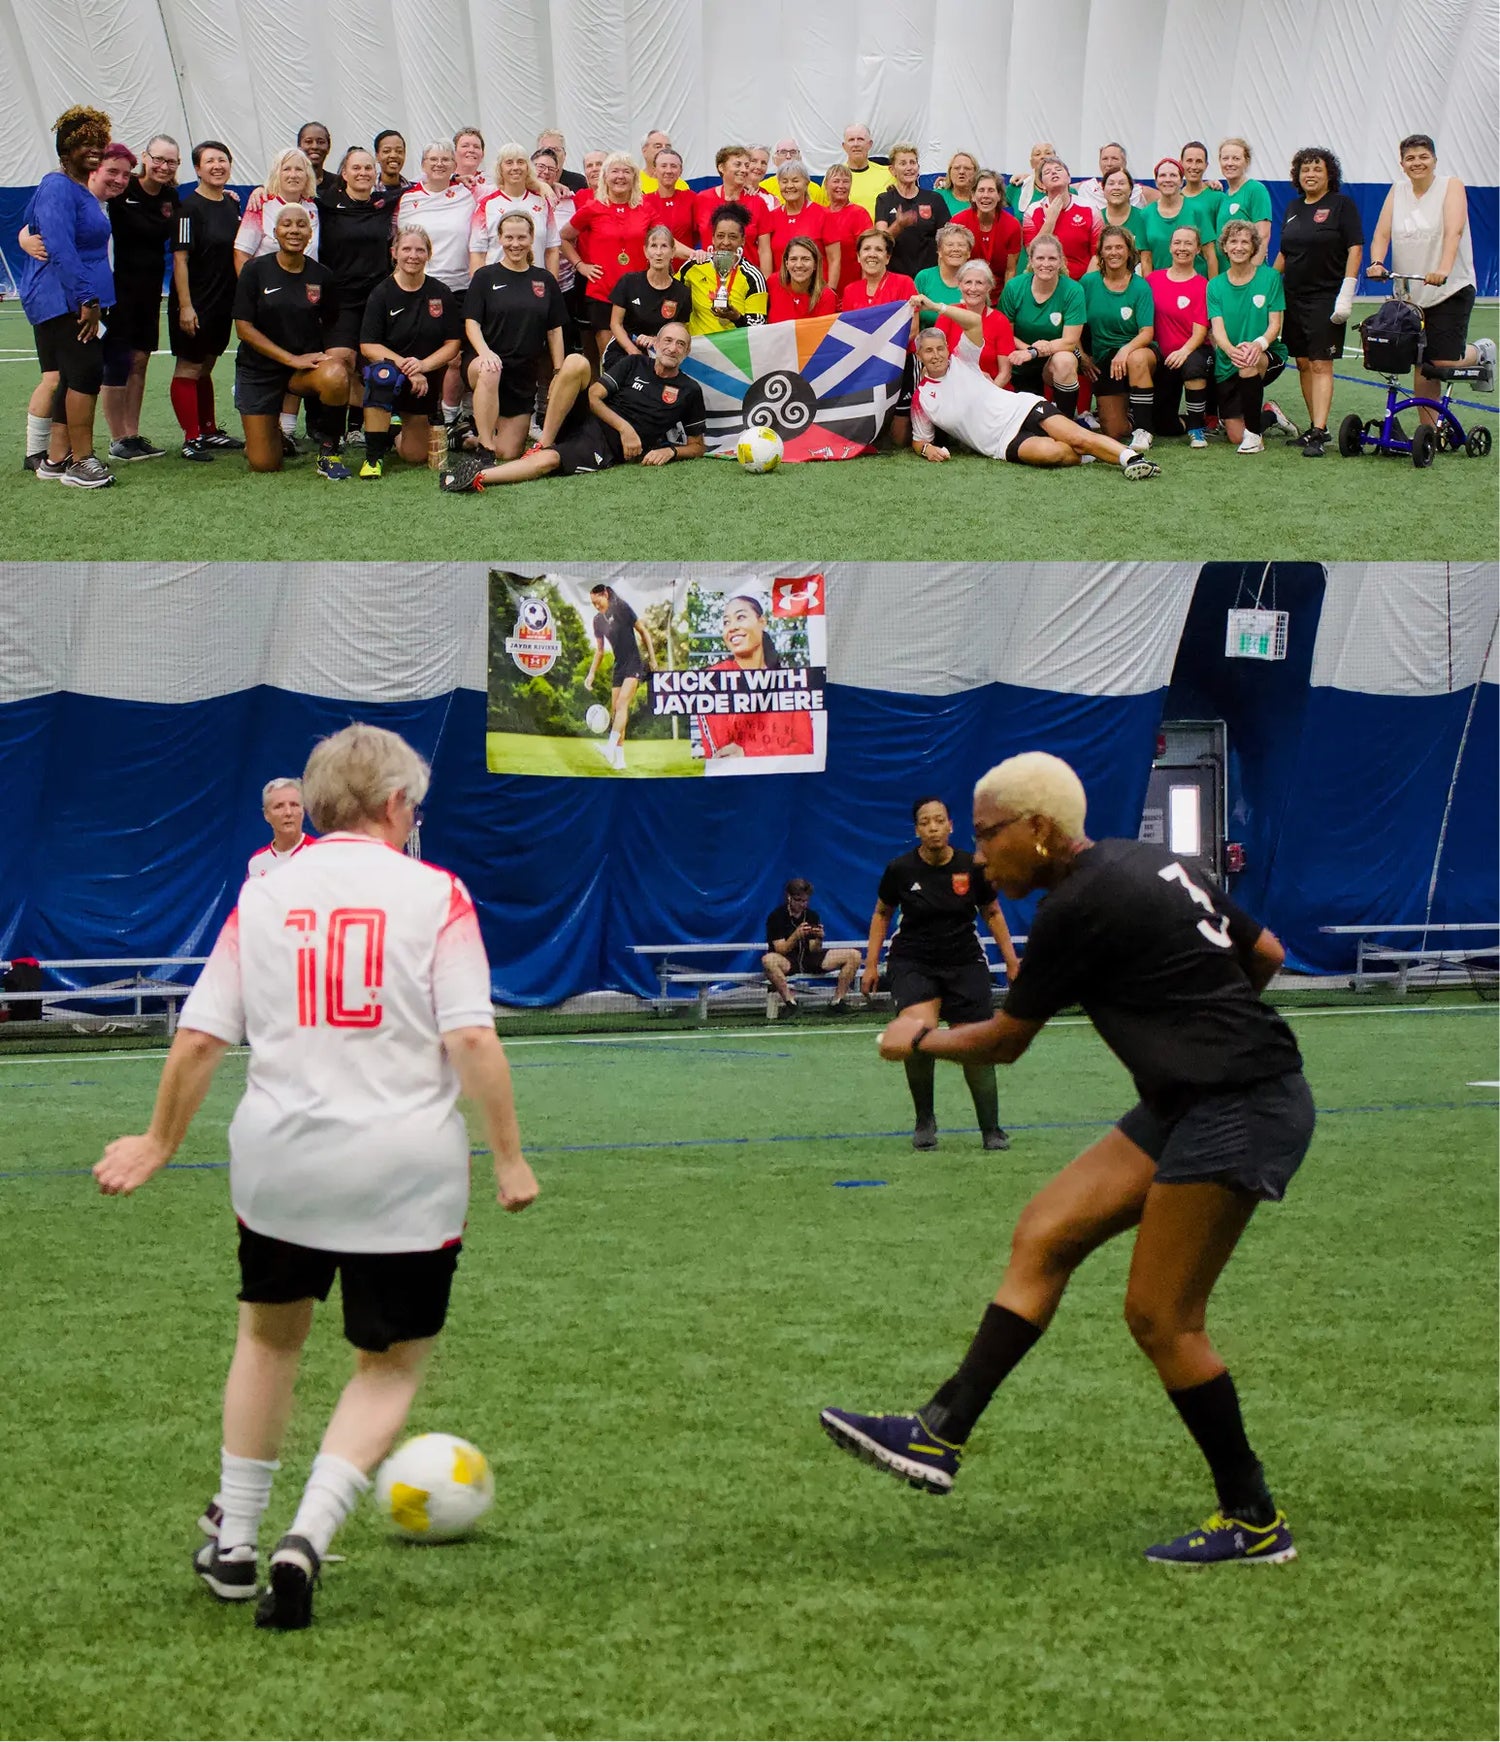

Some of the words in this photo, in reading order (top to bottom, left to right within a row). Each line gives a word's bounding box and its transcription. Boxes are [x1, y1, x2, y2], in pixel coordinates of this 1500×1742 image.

[632, 382, 644, 391] KH
[653, 671, 716, 692] KICK
[720, 671, 740, 691] IT
[744, 668, 807, 690] WITH
[653, 693, 729, 715] JAYDE
[734, 690, 823, 713] RIVIERE
[1157, 861, 1233, 948] 3
[284, 908, 385, 1028] 10
